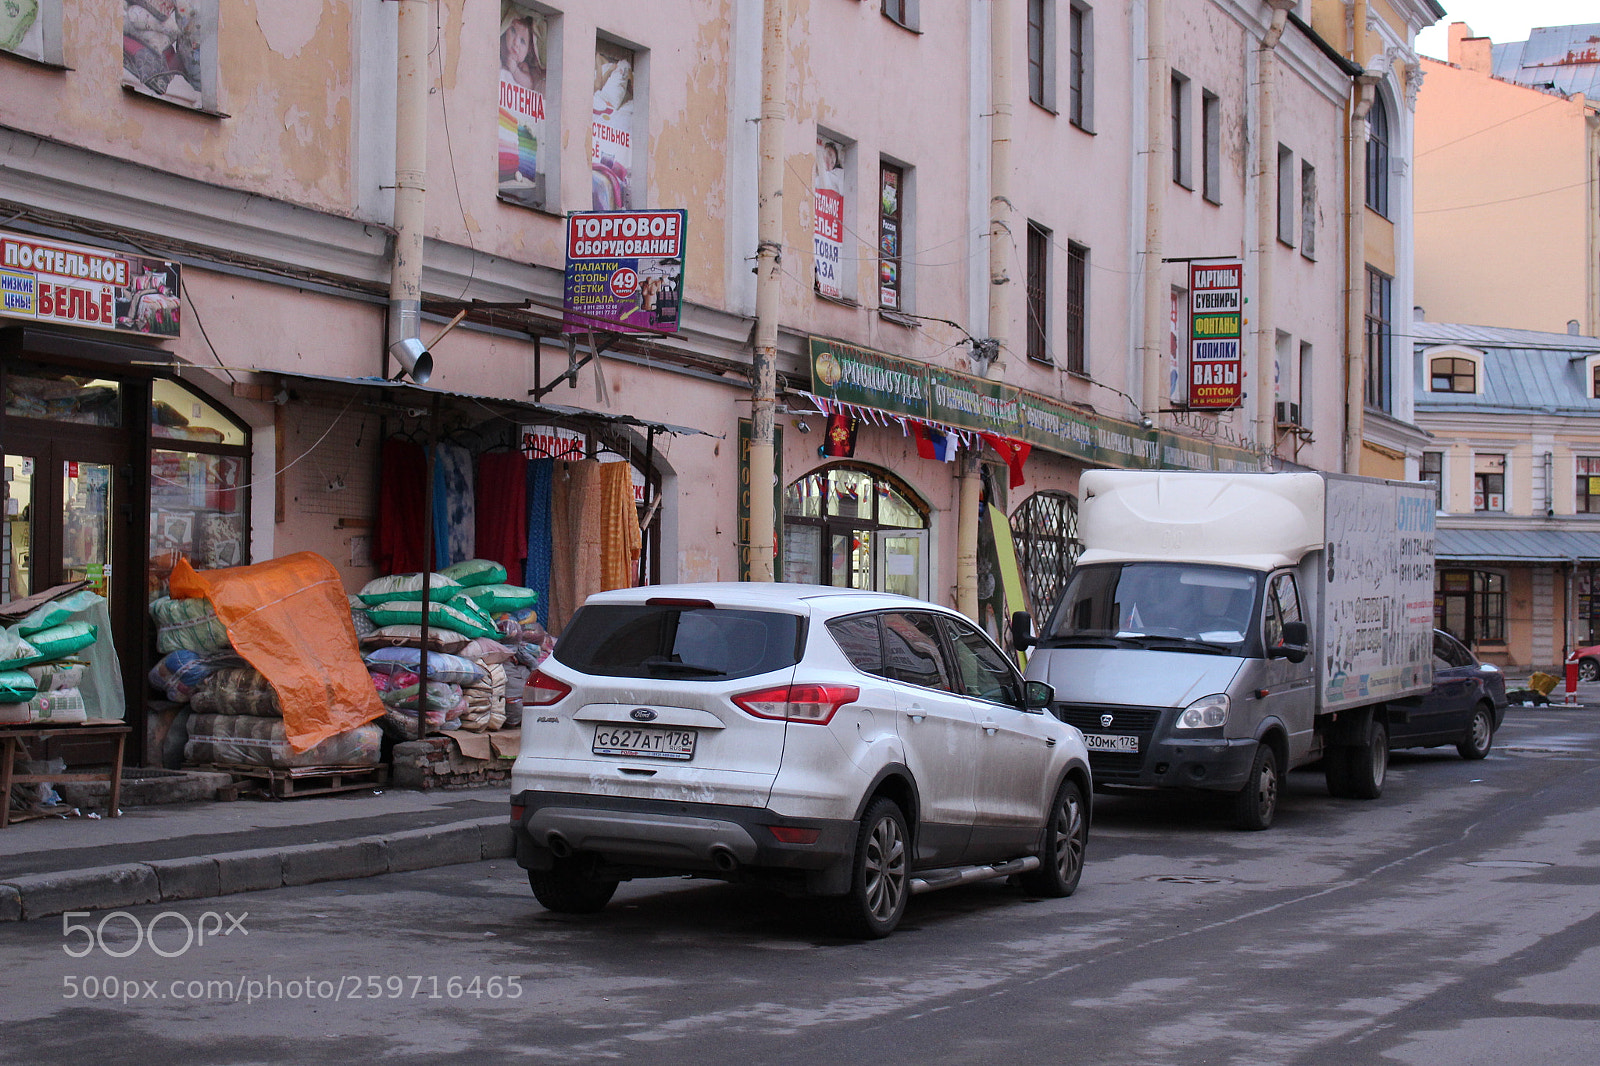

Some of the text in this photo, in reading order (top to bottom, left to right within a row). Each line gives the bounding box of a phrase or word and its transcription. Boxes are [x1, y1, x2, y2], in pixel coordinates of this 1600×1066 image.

[575, 216, 677, 238] ТОРГОВОЕ
[575, 239, 675, 257] ОБОРУДОВАНИЕ
[4, 242, 126, 286] ПОСТЕЛЬНОЕ
[574, 262, 619, 272] ПАЛАТКИ
[1, 275, 33, 293] НИЗКИЕ
[574, 273, 608, 283] СТОЛЫ
[613, 272, 636, 289] 49
[1194, 269, 1239, 288] КАРТИНЫ
[573, 284, 604, 294] СЕТКИ
[4, 292, 31, 310] ЦЕНЫ!
[38, 282, 113, 324] БЕЛЬЁ
[573, 295, 615, 305] ВЕШАЛА
[1195, 293, 1238, 309] СУВЕНИРЫ
[1195, 317, 1238, 335] ФОНТАНЫ
[1196, 342, 1237, 359] КОПИЛКИ
[841, 359, 922, 403] РОСПОСУДА
[1193, 364, 1238, 385] ВАЗЫ
[1197, 387, 1234, 396] ОПТОМ
[598, 729, 691, 750] С627АТ 178
[1119, 737, 1136, 746] 178
